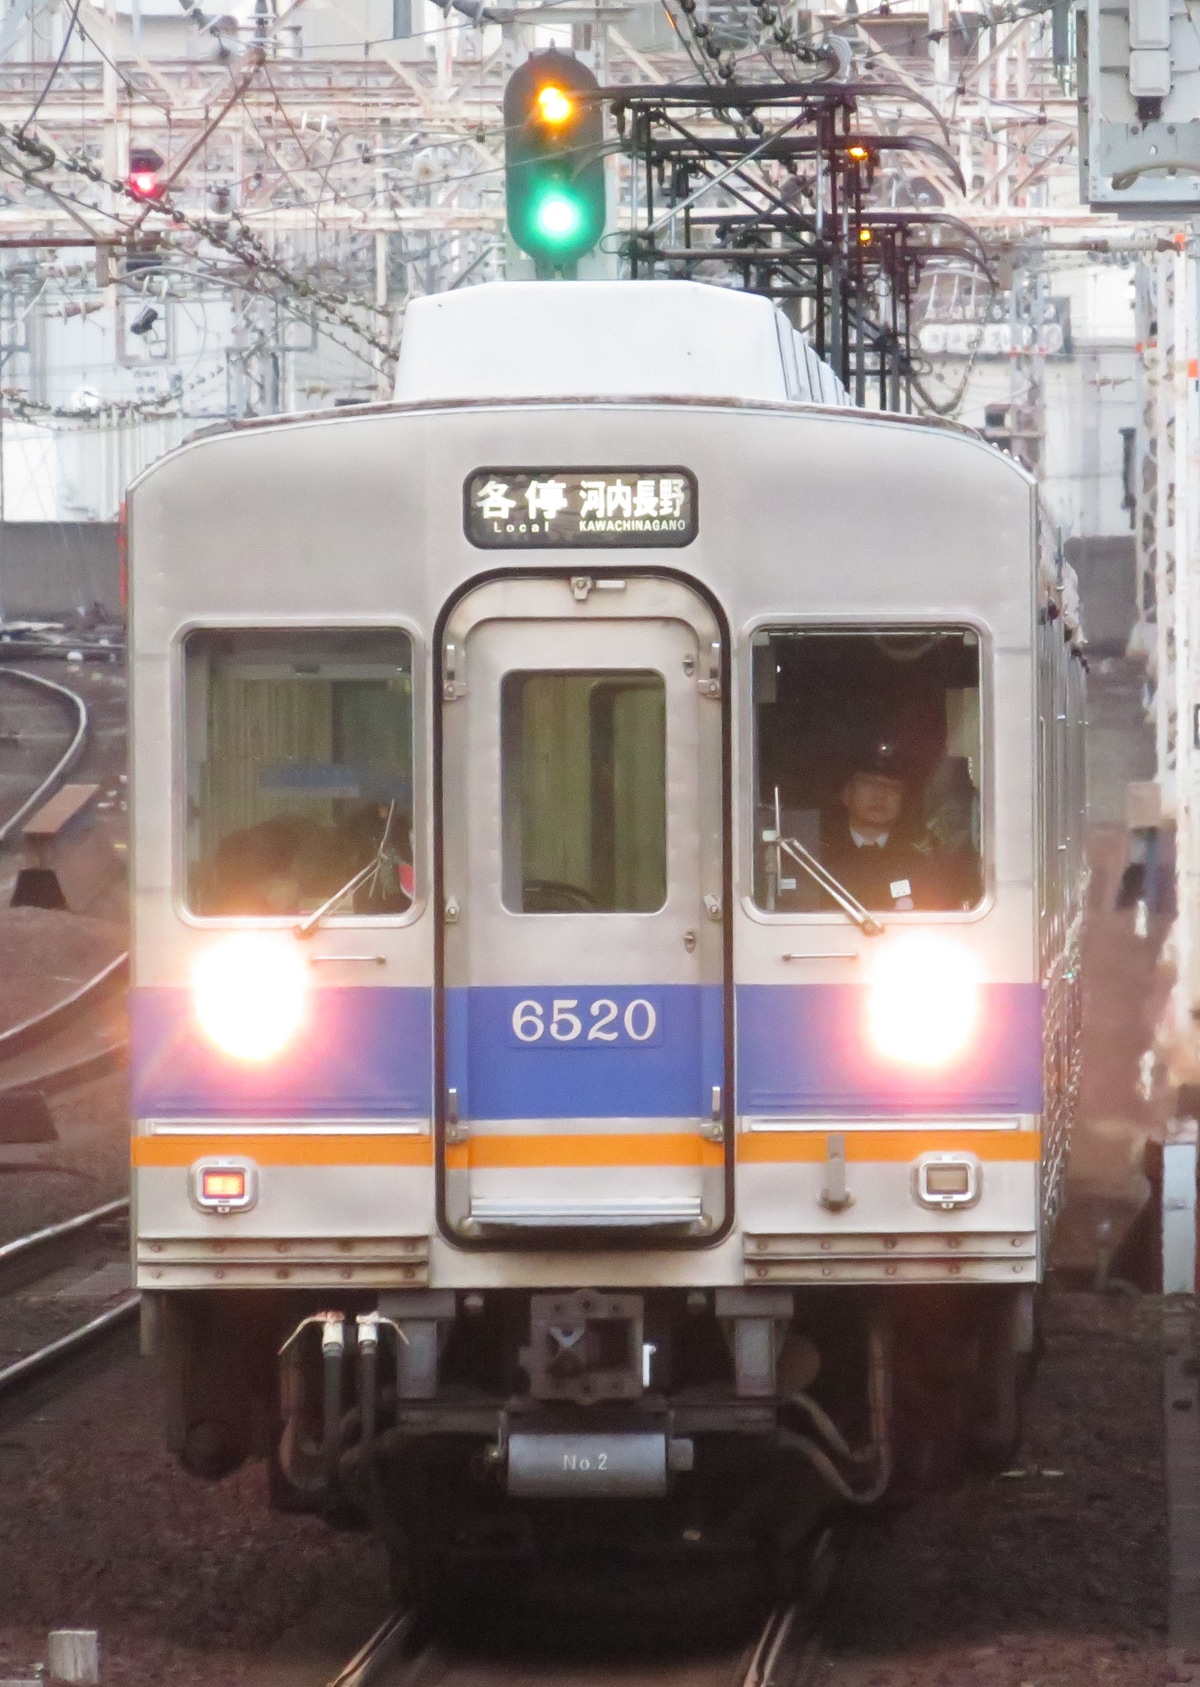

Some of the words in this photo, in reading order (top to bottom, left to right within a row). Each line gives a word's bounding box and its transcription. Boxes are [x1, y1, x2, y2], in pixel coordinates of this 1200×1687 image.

[476, 480, 568, 519] 各停
[579, 479, 685, 518] 河内長野
[493, 521, 549, 532] Local
[579, 519, 686, 532] KAWACHINAGANO
[512, 999, 656, 1041] 6520
[563, 1453, 608, 1471] No.2
